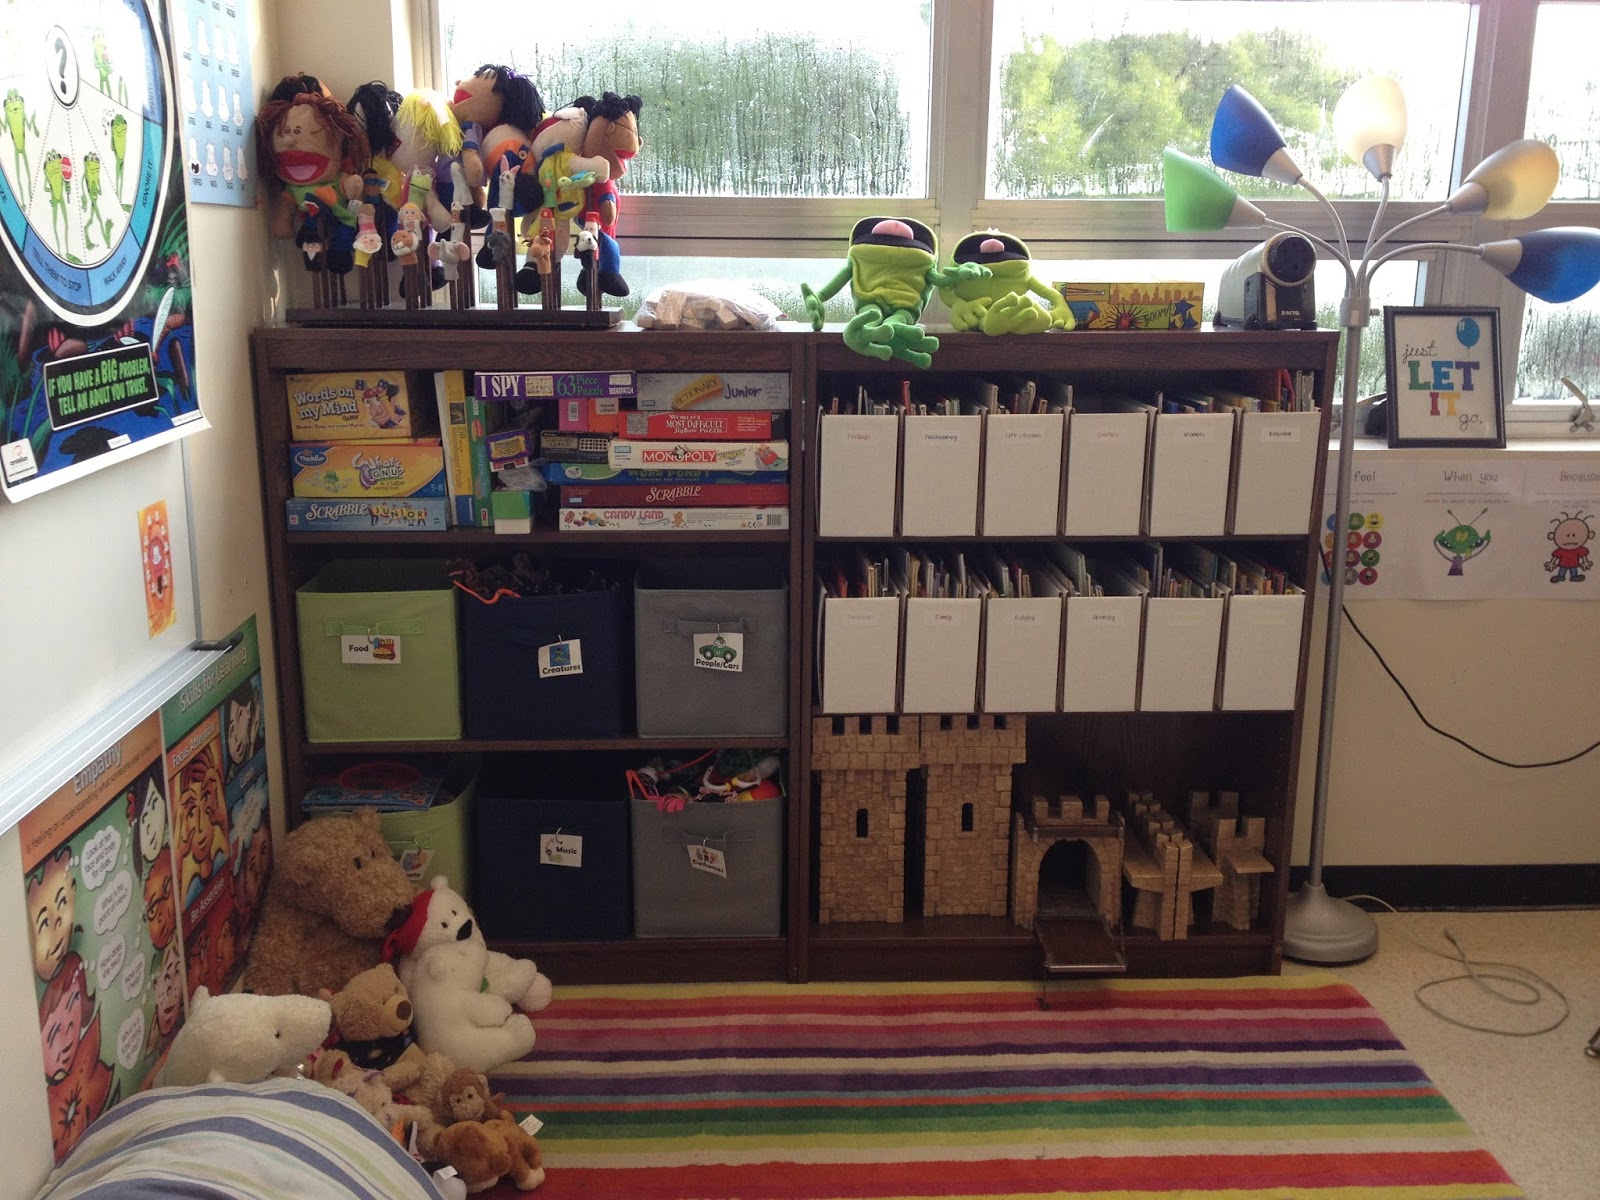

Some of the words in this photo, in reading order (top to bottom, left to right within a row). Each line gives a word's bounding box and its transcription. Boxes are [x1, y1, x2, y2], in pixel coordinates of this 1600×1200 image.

[68, 280, 82, 292] STOP
[1401, 340, 1438, 364] just
[48, 377, 56, 398] IF
[57, 373, 73, 395] YOU
[73, 369, 94, 391] HAVE
[95, 367, 101, 387] A
[101, 358, 118, 384] BIG
[1408, 360, 1480, 391] LET
[480, 375, 488, 398] I
[491, 375, 521, 397] SPY
[556, 374, 577, 396] 63
[576, 375, 598, 385] Piece
[576, 386, 604, 396] Puzzle
[675, 379, 719, 407] PICTIONARY
[724, 383, 762, 400] Junior
[58, 394, 77, 417] TELL
[77, 391, 89, 412] AN
[89, 385, 111, 409] ADULT
[111, 381, 126, 402] YOU
[293, 387, 337, 406] Words
[339, 387, 355, 398] on
[1429, 391, 1461, 416] IT
[299, 407, 320, 421] my
[320, 400, 359, 416] Mind
[666, 420, 686, 428] MOST
[1459, 413, 1483, 431] go.
[643, 451, 717, 463] MONOPOLY
[1353, 471, 1376, 483] feel
[1443, 471, 1473, 483] When
[1479, 472, 1498, 484] you
[646, 486, 703, 502] SCRABBLE
[306, 503, 369, 521] SCRABBLE
[374, 506, 426, 519] JUNIOR
[603, 510, 636, 520] CANDY
[638, 510, 664, 520] LAND
[349, 644, 369, 652] Food
[542, 664, 581, 675] Creatures
[695, 658, 739, 670] People/Cars
[180, 681, 203, 713] Skills
[203, 672, 215, 694] for
[216, 647, 247, 682] Learning
[74, 743, 123, 795] Empathy
[556, 846, 577, 855] Music
[692, 859, 724, 873] Costumes
